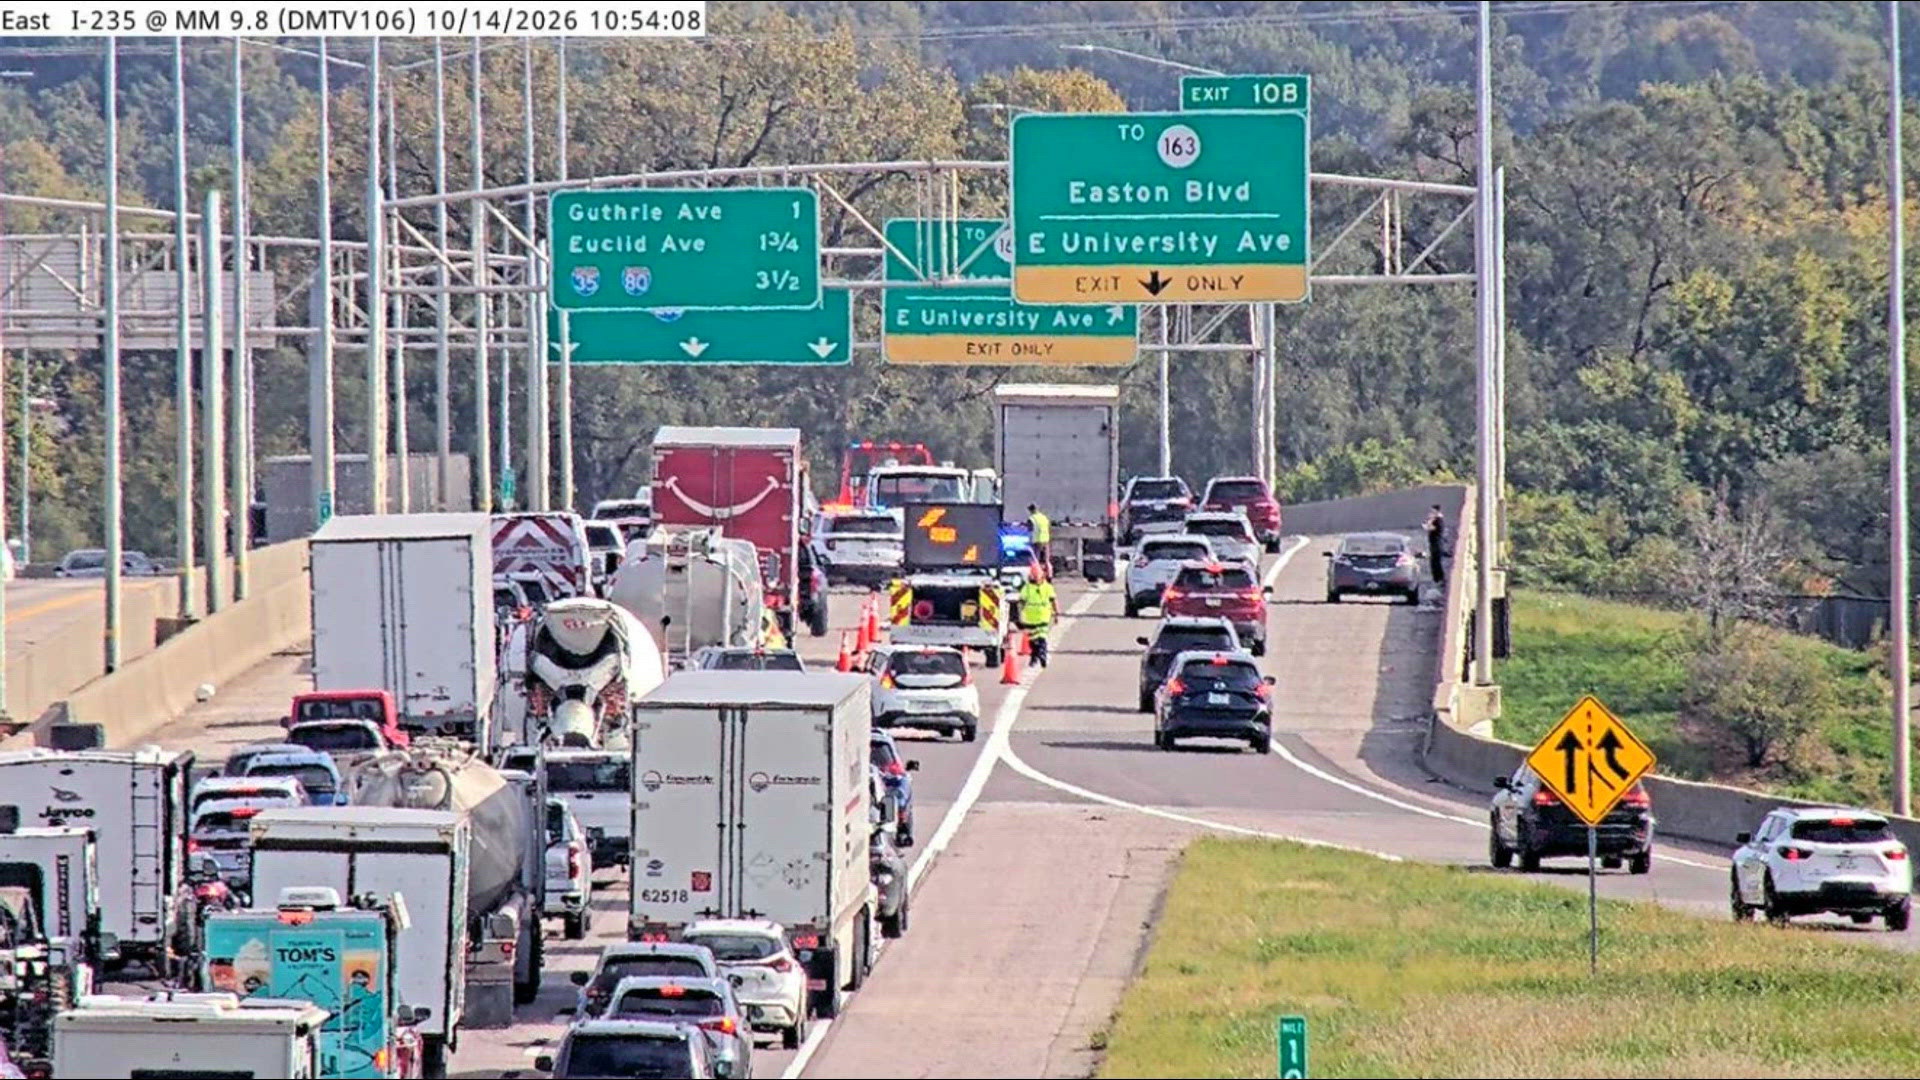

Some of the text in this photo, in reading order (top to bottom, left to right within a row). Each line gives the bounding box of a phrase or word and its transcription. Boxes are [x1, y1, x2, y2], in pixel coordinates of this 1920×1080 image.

[1191, 82, 1298, 104] EXIT 10B
[1118, 123, 1145, 141] TO
[1163, 136, 1196, 158] 163
[1069, 180, 1250, 204] Easton Blvd
[568, 200, 800, 221] Guthrie Ave 1
[569, 235, 647, 253] Euclid
[660, 234, 706, 253] Ave
[965, 227, 985, 241] TO
[1029, 230, 1291, 258] E University Ave
[574, 274, 599, 290] 35
[623, 274, 649, 289] 80
[1075, 274, 1244, 294] EXIT ONLY
[897, 308, 1093, 331] E University Ave
[966, 342, 1054, 356] EXIT ONLY
[641, 889, 689, 904] 62518
[276, 948, 336, 963] TOM'S
